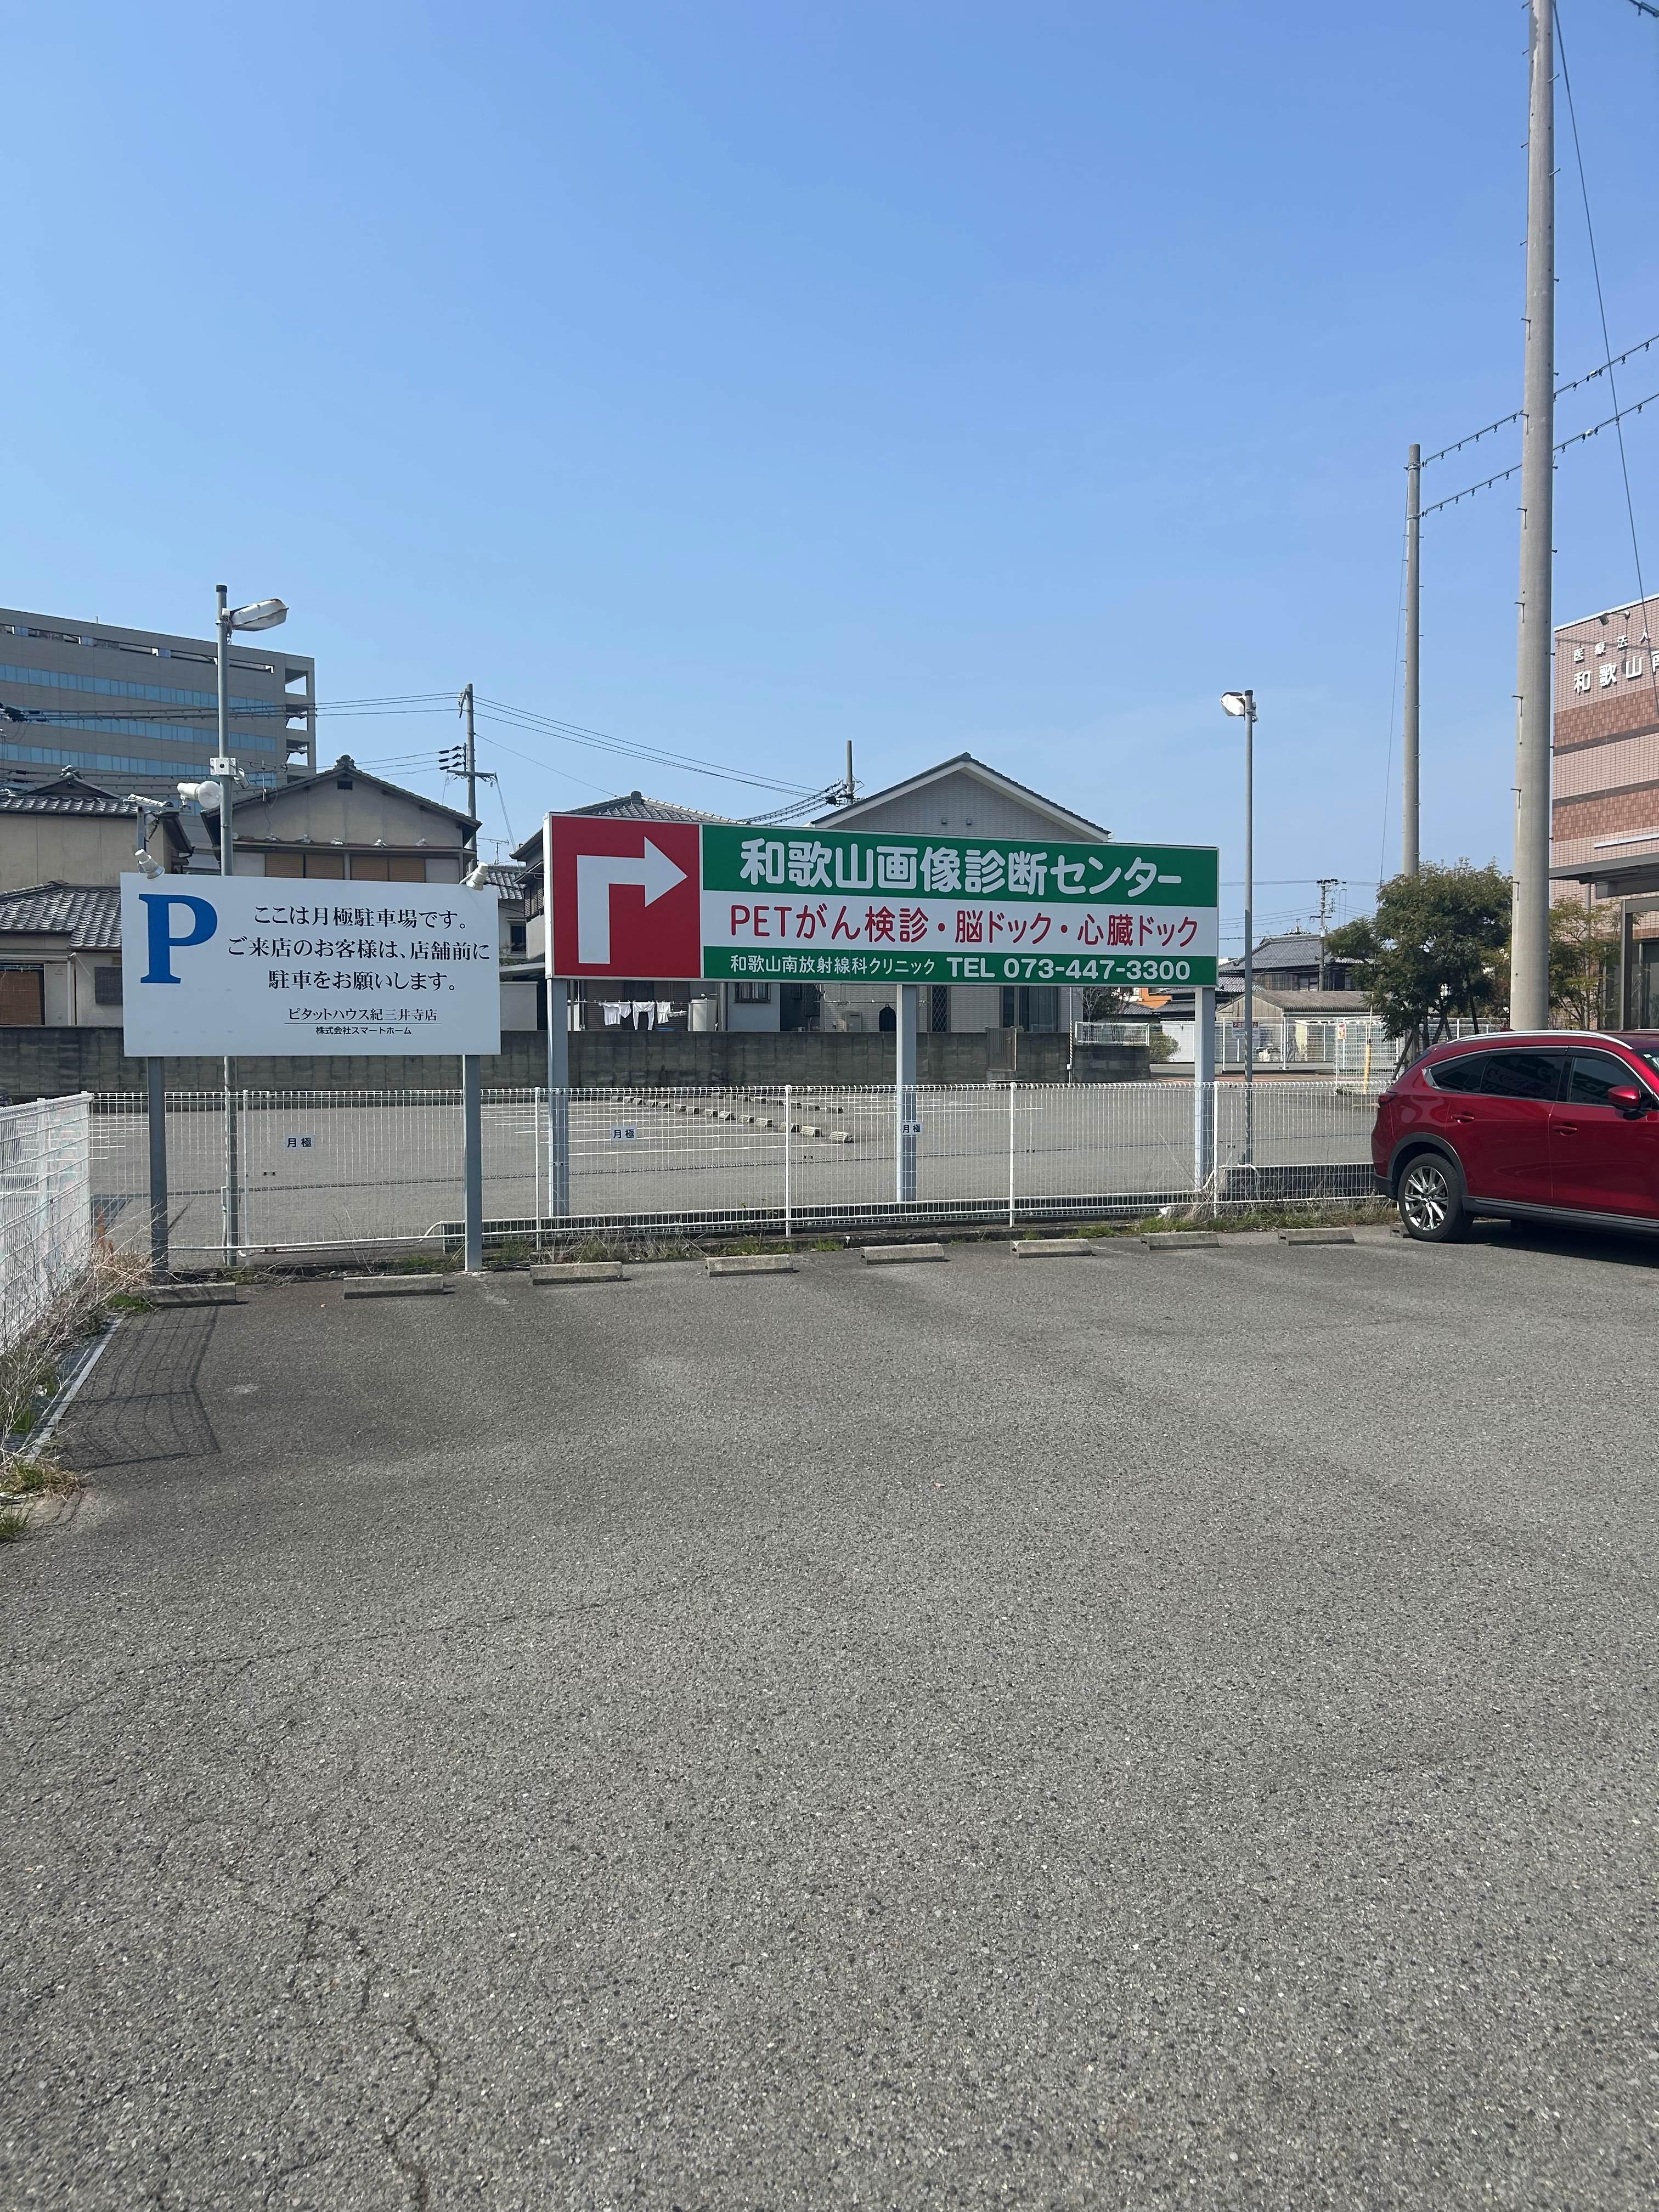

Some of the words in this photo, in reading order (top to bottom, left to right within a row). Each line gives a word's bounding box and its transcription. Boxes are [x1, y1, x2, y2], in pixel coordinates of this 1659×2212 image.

[1574, 628, 1651, 662] 医療法人
[741, 838, 1182, 898] 和歌山画像診断センター
[254, 906, 466, 929] ここは月極駐車場です。
[731, 903, 1198, 947] PETがん検診・脳ドック・心臓ドック
[138, 893, 218, 984] P
[228, 936, 490, 961] ご来店のお客様は、店舗前に
[730, 955, 935, 975] 和歌山南放射線科クリニック
[947, 958, 995, 978] TEL
[1003, 958, 1190, 981] 073-447-3300
[268, 969, 455, 991] 駐車をお願いします。
[289, 1007, 437, 1021] ピタットハウス紀三井寺店
[315, 1026, 412, 1035] 株式会社スマートホーム
[613, 1128, 634, 1138] 月極
[902, 1124, 921, 1133] 月極
[287, 1137, 312, 1148] 月極
